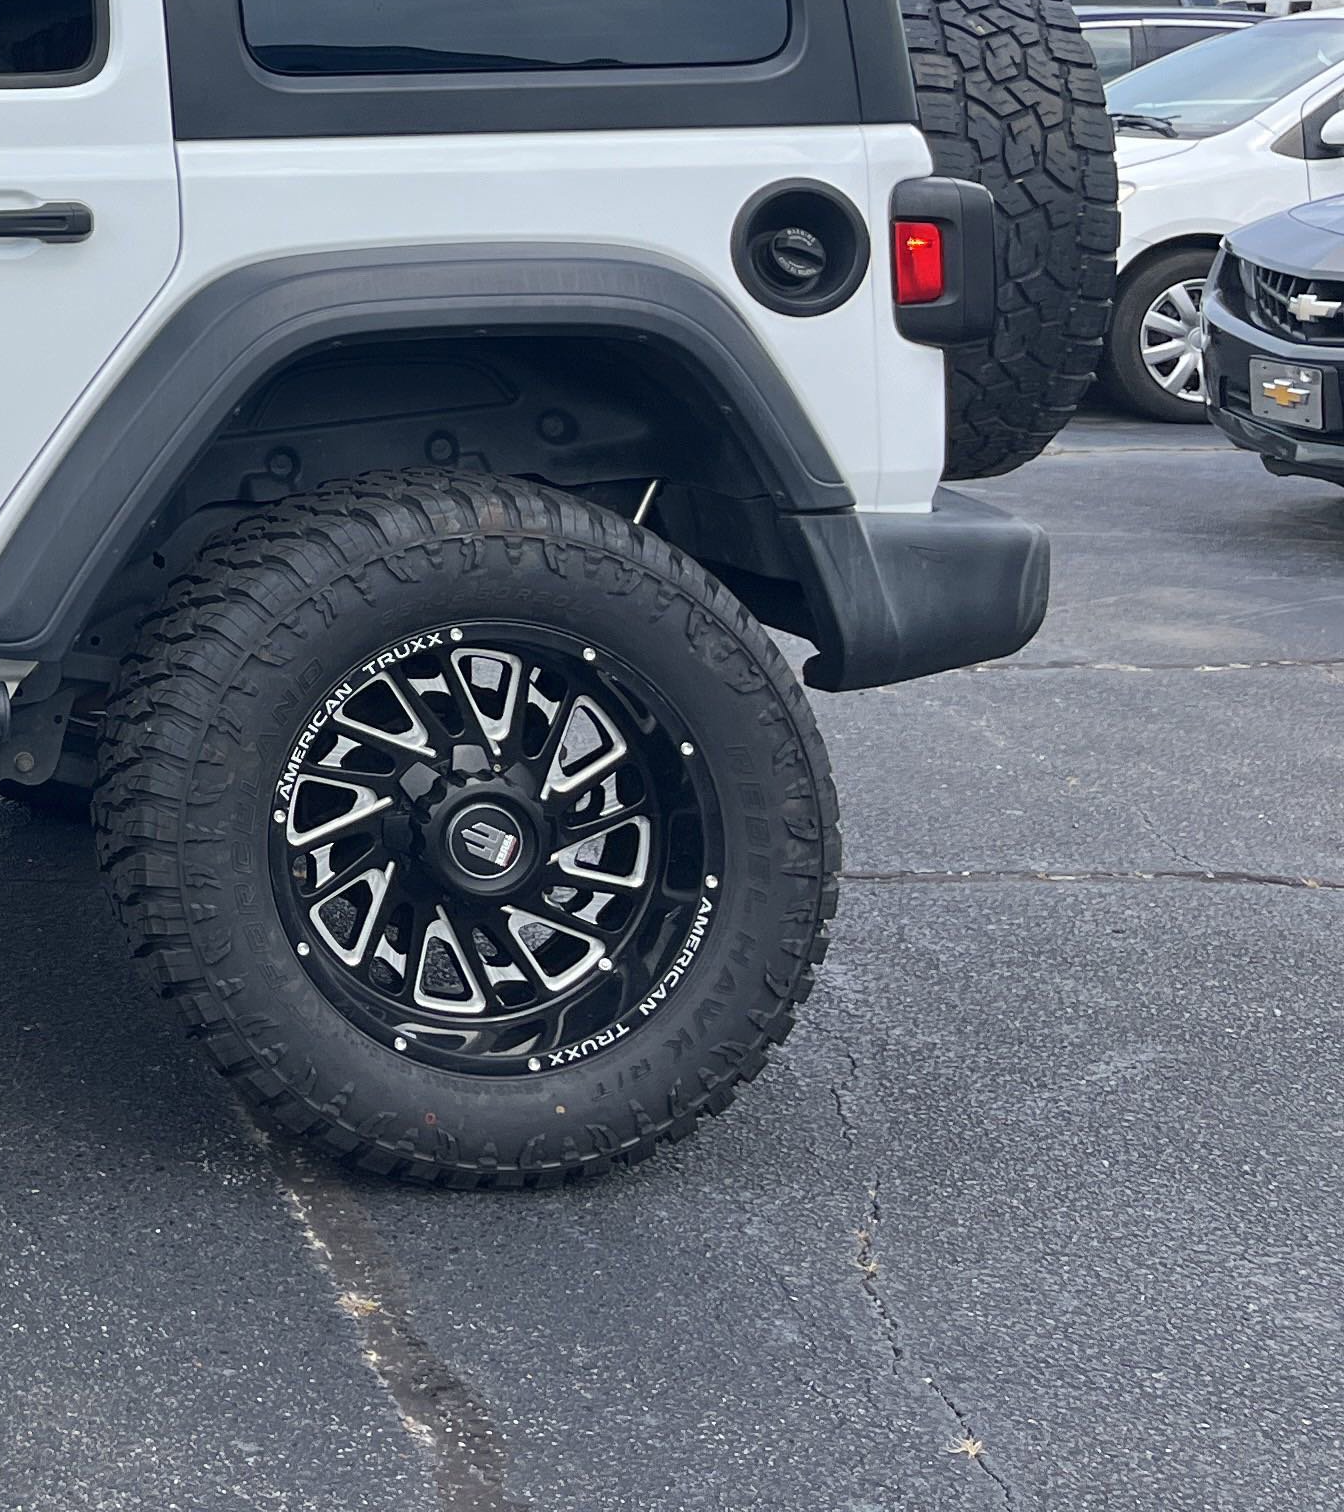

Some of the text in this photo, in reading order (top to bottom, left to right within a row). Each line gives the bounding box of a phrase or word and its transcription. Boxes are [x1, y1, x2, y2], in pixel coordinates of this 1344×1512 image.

[275, 631, 444, 801] AMERICAN TRUXX
[547, 896, 713, 1068] AMERICAN TRUXX
